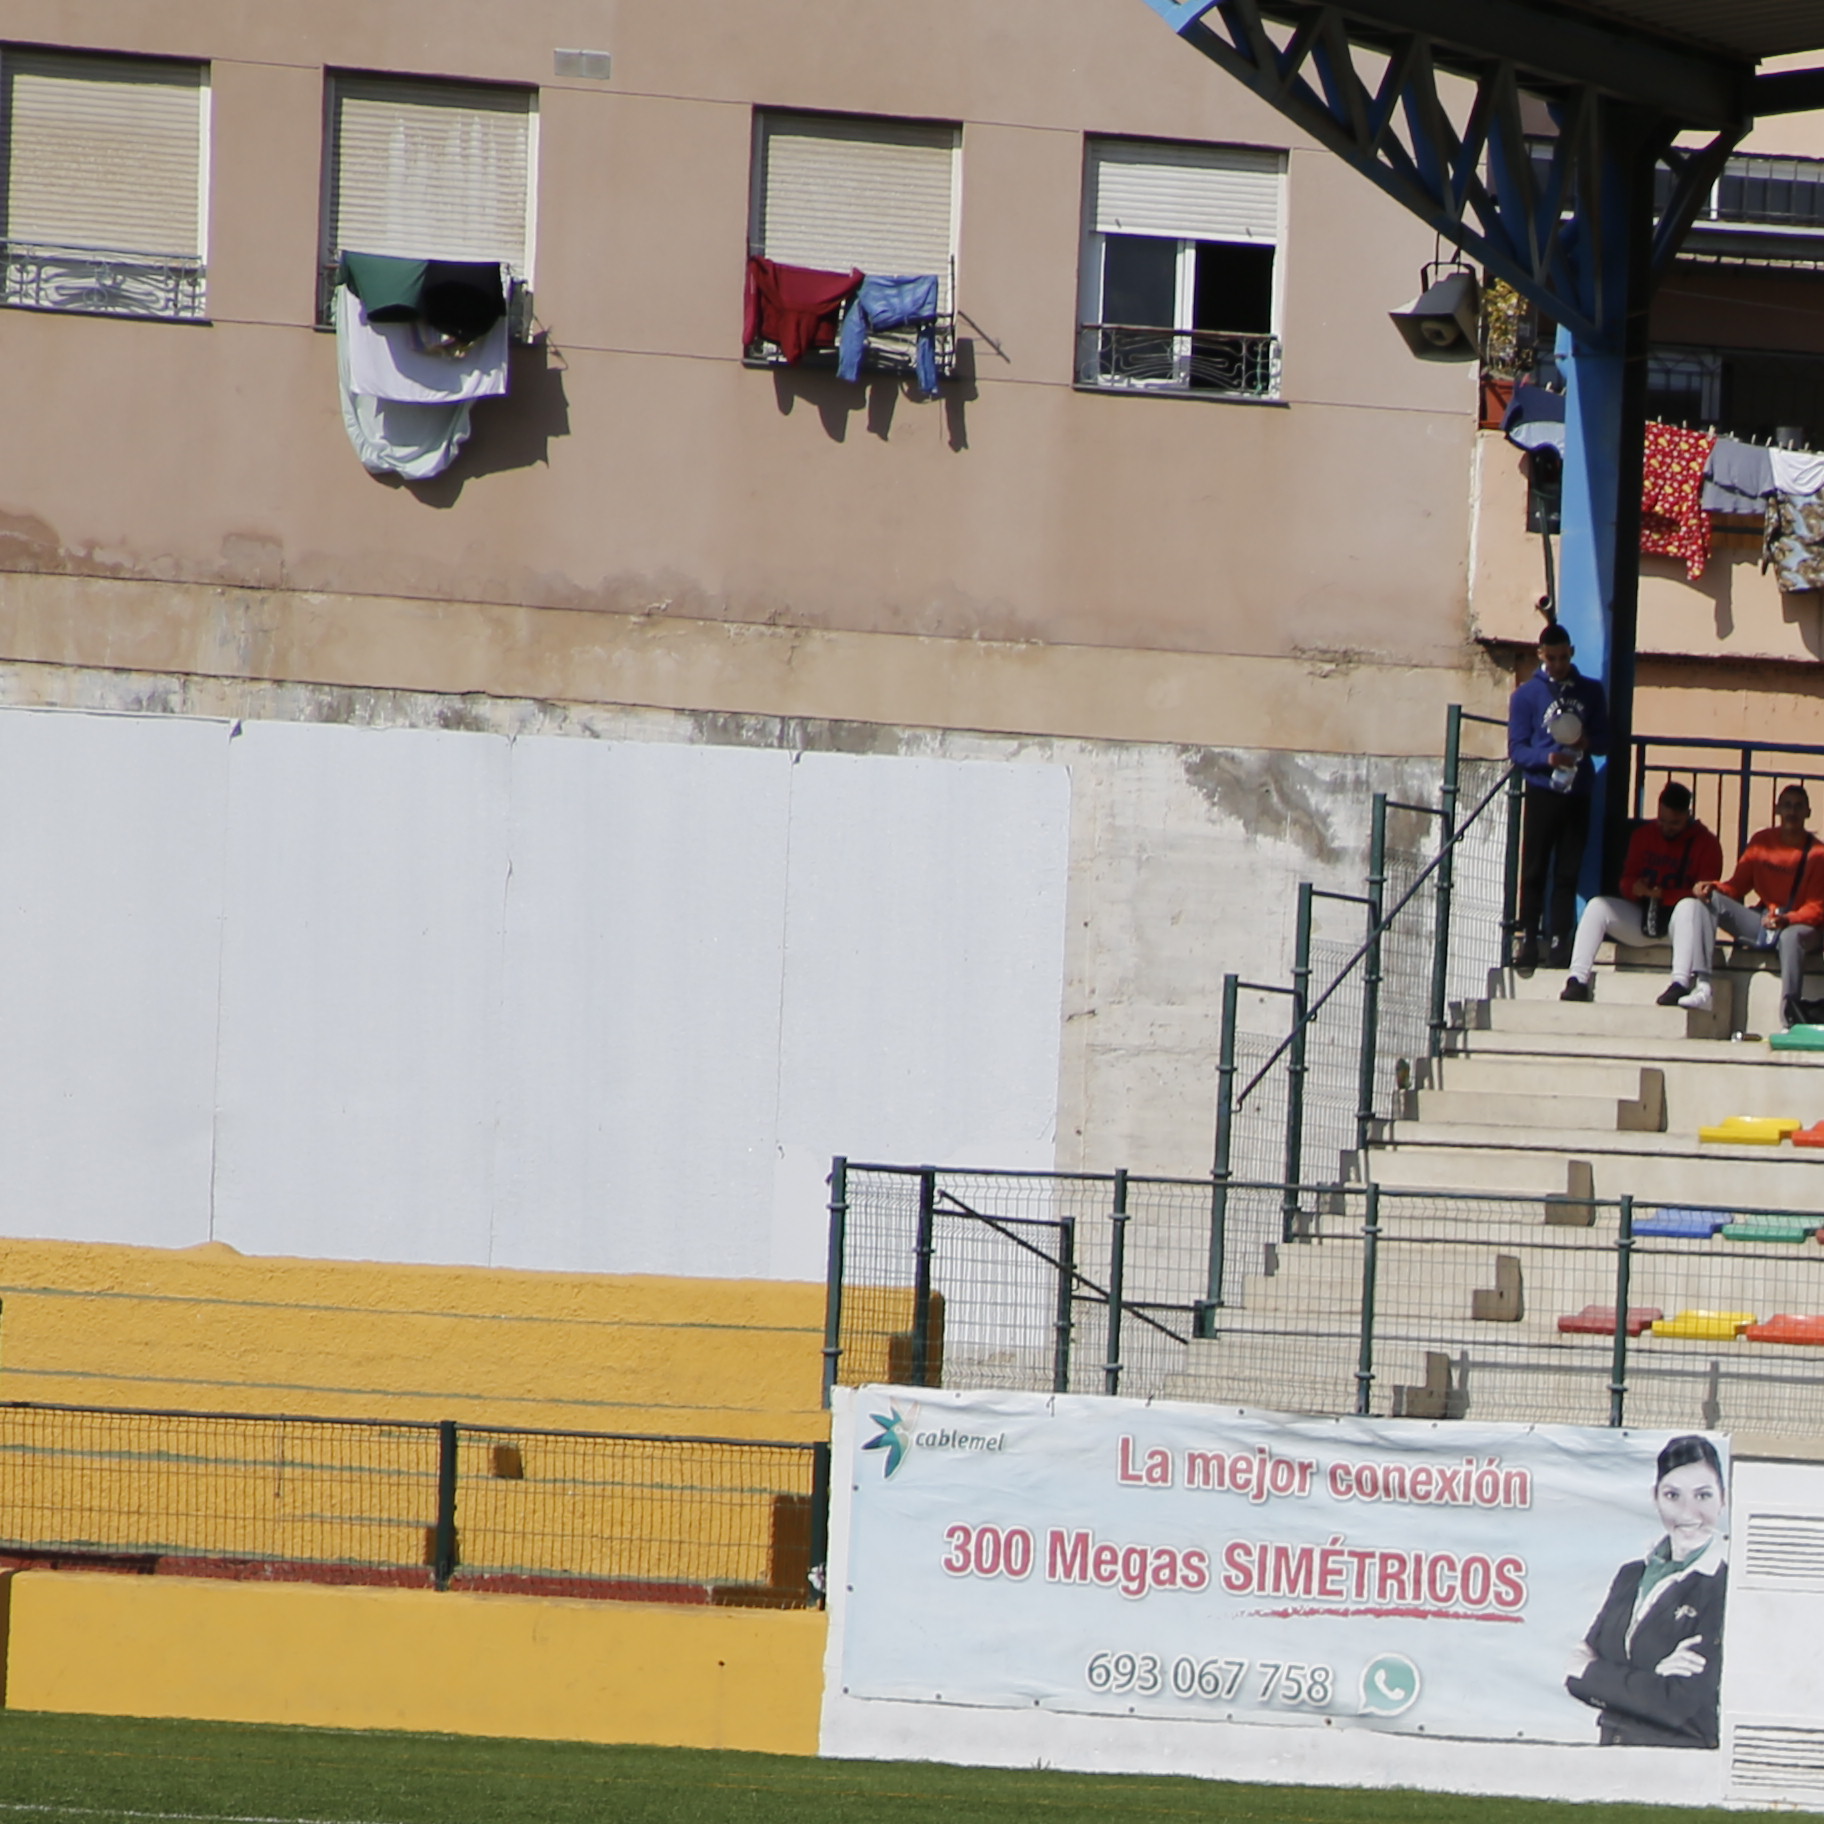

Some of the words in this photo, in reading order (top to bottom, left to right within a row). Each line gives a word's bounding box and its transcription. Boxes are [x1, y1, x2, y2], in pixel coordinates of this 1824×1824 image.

[914, 1427, 1005, 1452] cablemel
[1118, 1436, 1171, 1485] La
[1186, 1446, 1315, 1502] mejor
[1328, 1457, 1528, 1507] conexión
[943, 1525, 1032, 1577] 300
[1047, 1529, 1207, 1597] Megas
[1223, 1536, 1526, 1608] SIMÉTRICOS
[1087, 1652, 1159, 1691] 693
[1172, 1656, 1245, 1696] 067
[1258, 1662, 1331, 1703] 758
